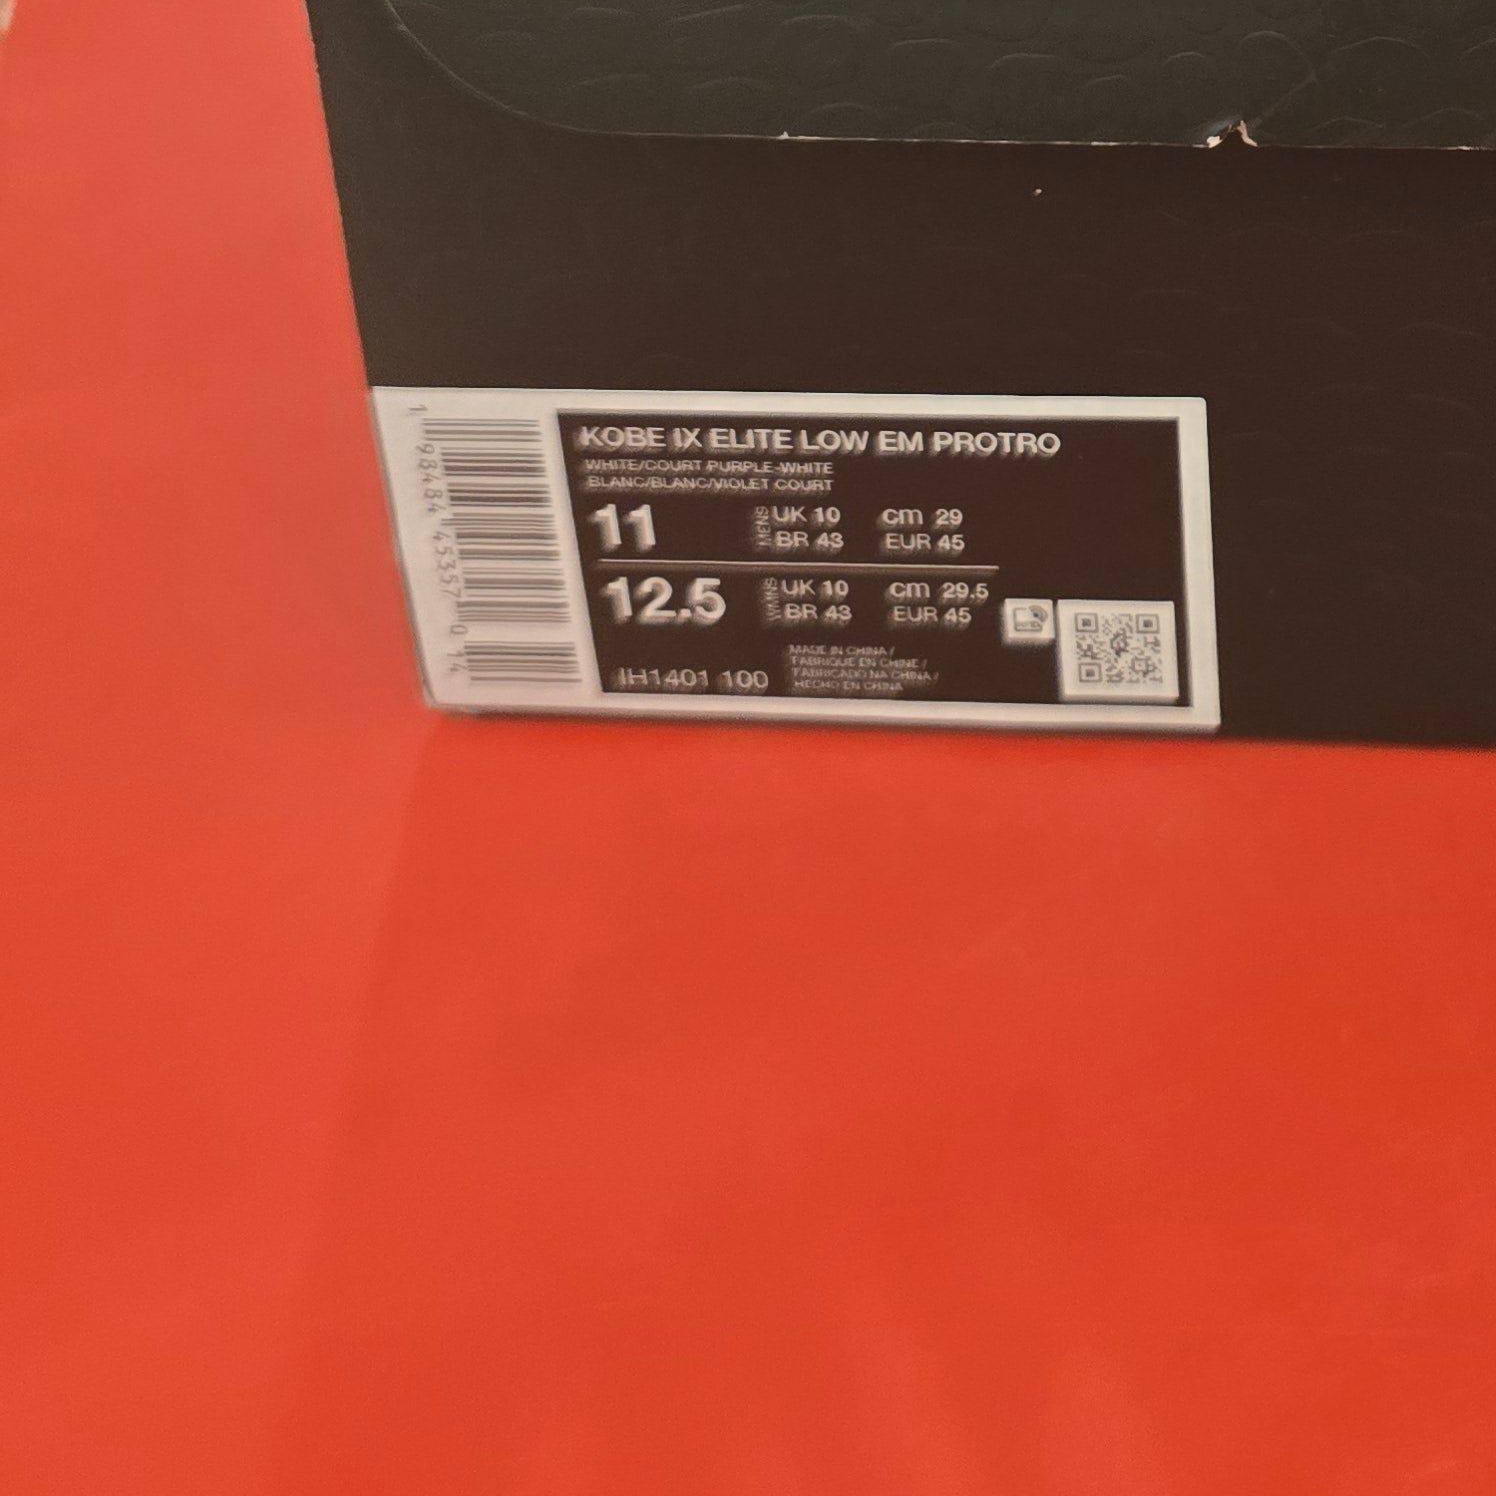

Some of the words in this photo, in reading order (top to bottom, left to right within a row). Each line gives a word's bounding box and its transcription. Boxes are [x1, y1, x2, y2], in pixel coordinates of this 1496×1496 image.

[579, 426, 667, 448] KOBE
[672, 427, 703, 449] IX
[710, 428, 794, 450] ELITE
[800, 429, 869, 452] LOW
[878, 430, 925, 452] EM
[932, 431, 1061, 454] PROTRO
[585, 459, 702, 472] WHITE/COURT
[706, 460, 834, 475] PURPLE-WHITE
[587, 476, 769, 490] BLANC/BLANC/VIOLET
[774, 478, 834, 492] COURT
[415, 443, 447, 515] 98484
[432, 530, 462, 598] 45357
[771, 505, 808, 524] UK
[812, 506, 842, 525] 10
[881, 508, 924, 526] cm
[934, 508, 964, 526] 29
[591, 503, 657, 546] 11
[754, 506, 771, 547] MENS
[774, 531, 810, 549] BR
[816, 531, 845, 549] 43
[885, 532, 932, 551] EUR
[936, 533, 966, 551] 45
[781, 579, 816, 596] UK
[821, 579, 850, 597] 10
[888, 582, 931, 599] cm
[940, 582, 990, 600] 29.5
[605, 576, 727, 621] 12.5
[783, 603, 819, 621] BR
[824, 604, 853, 621] 43
[892, 606, 939, 623] EUR
[943, 606, 973, 624] 45
[788, 644, 827, 655] MADE
[830, 645, 844, 656] IN
[845, 646, 888, 656] CHINA
[617, 667, 710, 687] IH1401
[720, 669, 770, 689] 100
